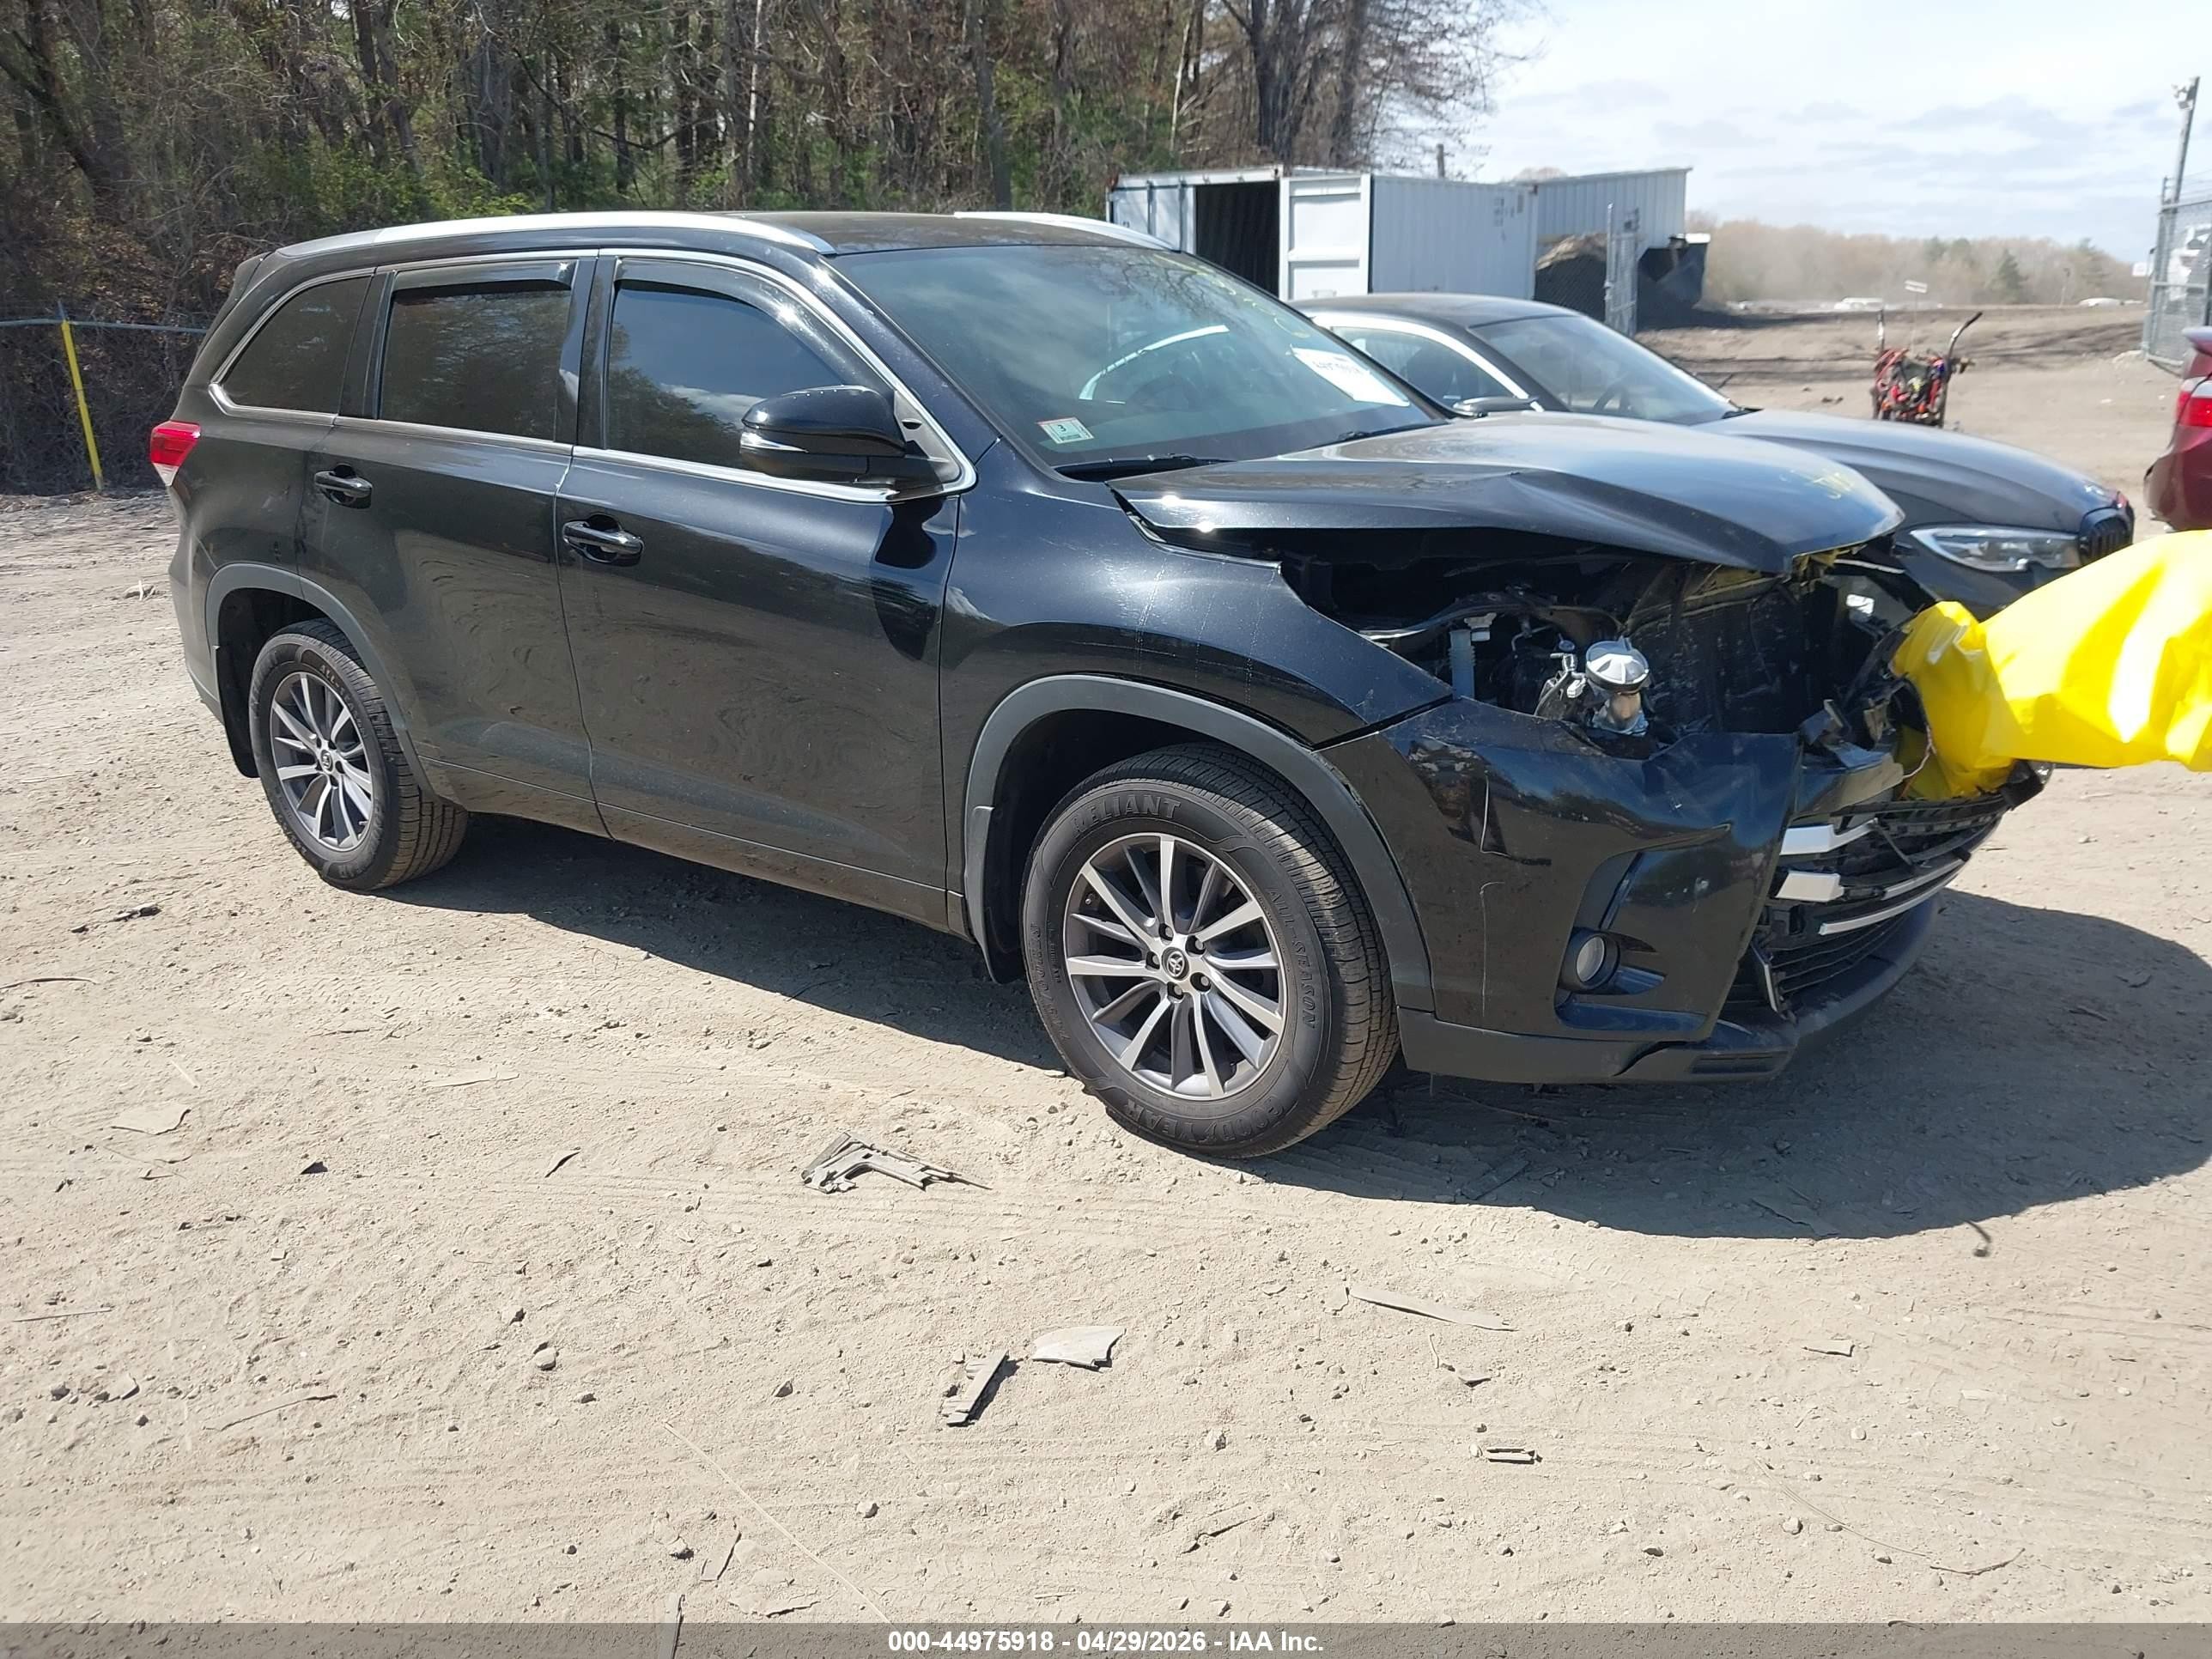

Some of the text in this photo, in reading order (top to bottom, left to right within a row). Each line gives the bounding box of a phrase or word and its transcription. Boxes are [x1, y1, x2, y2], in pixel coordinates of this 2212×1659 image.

[1073, 793, 1182, 839] RELIANT
[1265, 888, 1317, 1030] ALL-SEASON
[1123, 1097, 1285, 1144] GOODYEAR
